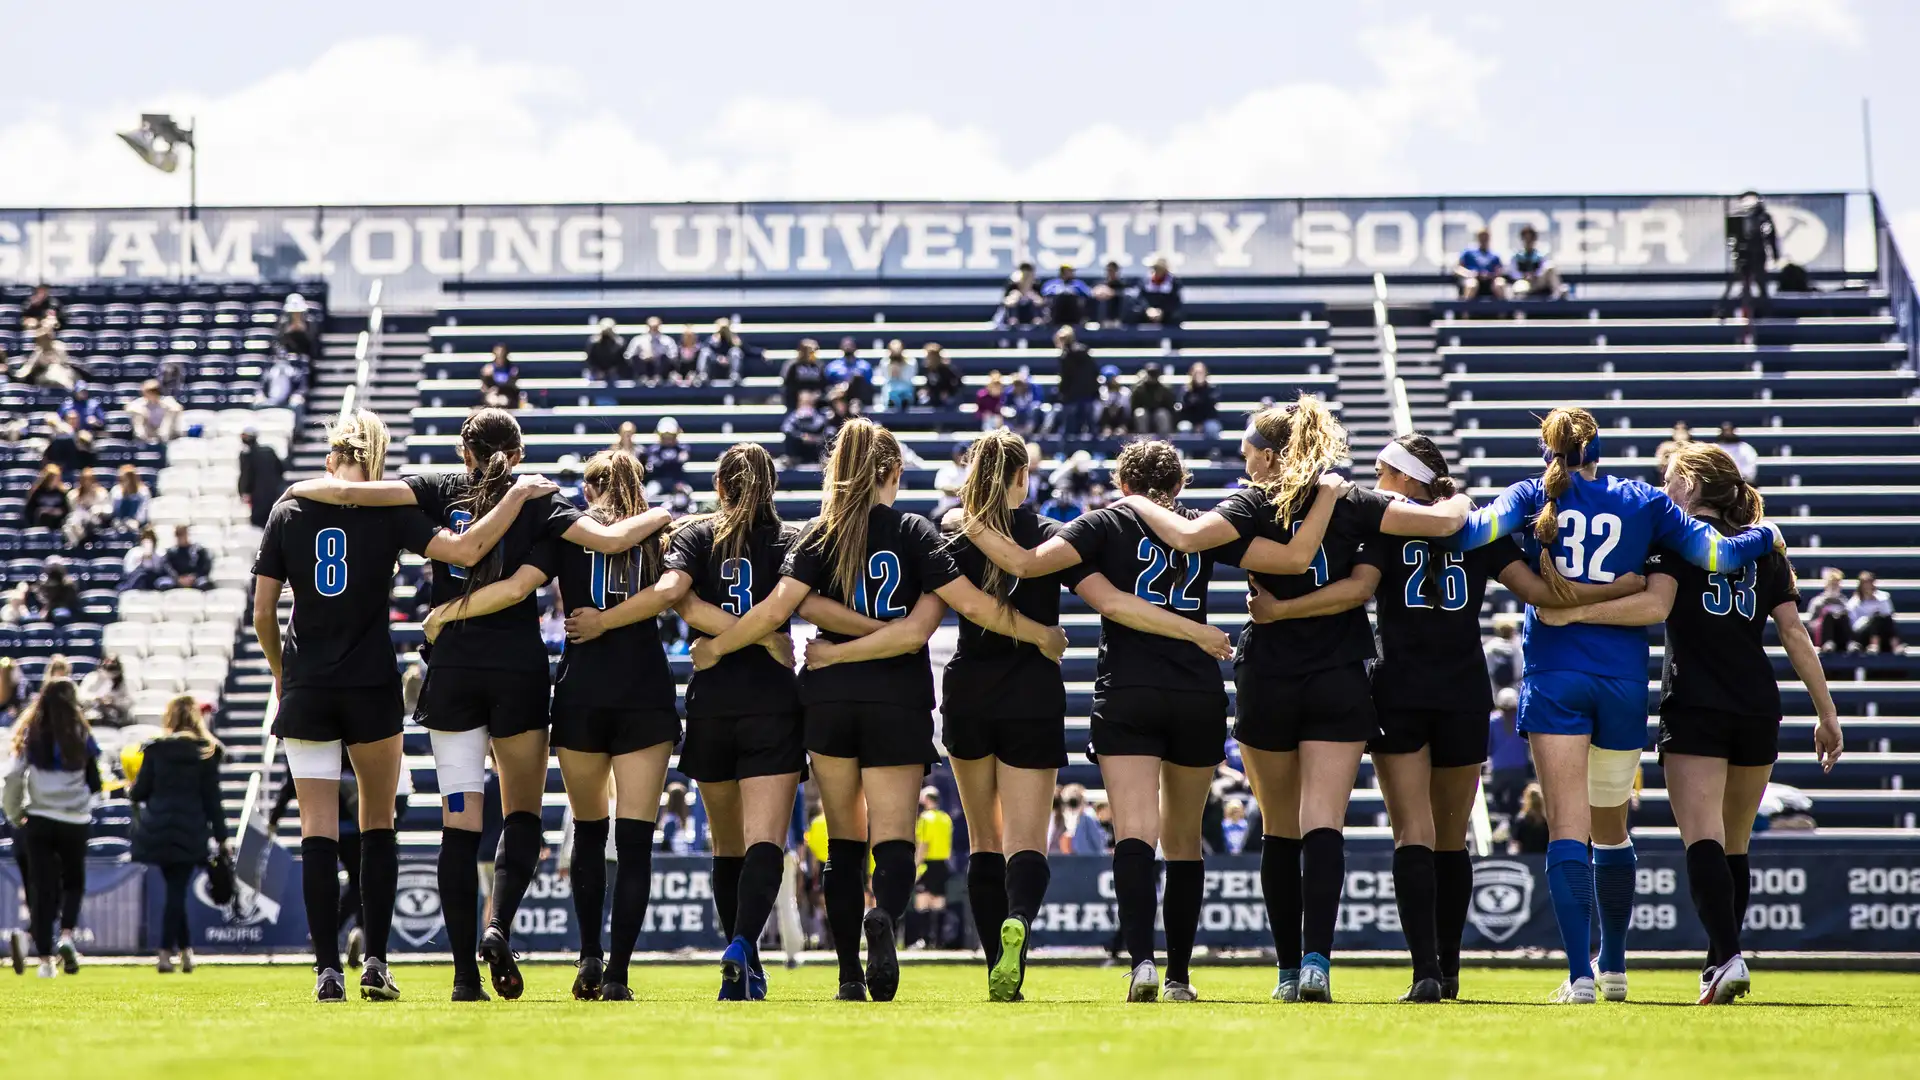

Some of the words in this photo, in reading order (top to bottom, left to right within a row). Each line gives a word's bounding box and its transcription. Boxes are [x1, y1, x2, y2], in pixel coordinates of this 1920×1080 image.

[282, 216, 624, 275] YOUNG
[651, 212, 1267, 273] UNIVERSITY
[1292, 209, 1689, 268] SOCCER
[315, 527, 348, 597] 8
[1555, 509, 1622, 582] 32
[584, 544, 643, 609] 14
[721, 557, 753, 615] 3
[1135, 536, 1201, 611] 22
[1403, 540, 1469, 611] 26
[523, 873, 572, 899] 03
[1634, 868, 1677, 895] 96
[1749, 868, 1806, 895] 000
[511, 907, 568, 934] 012
[641, 904, 704, 932] ITE
[1633, 904, 1677, 930] 99
[1743, 904, 1805, 930] 001
